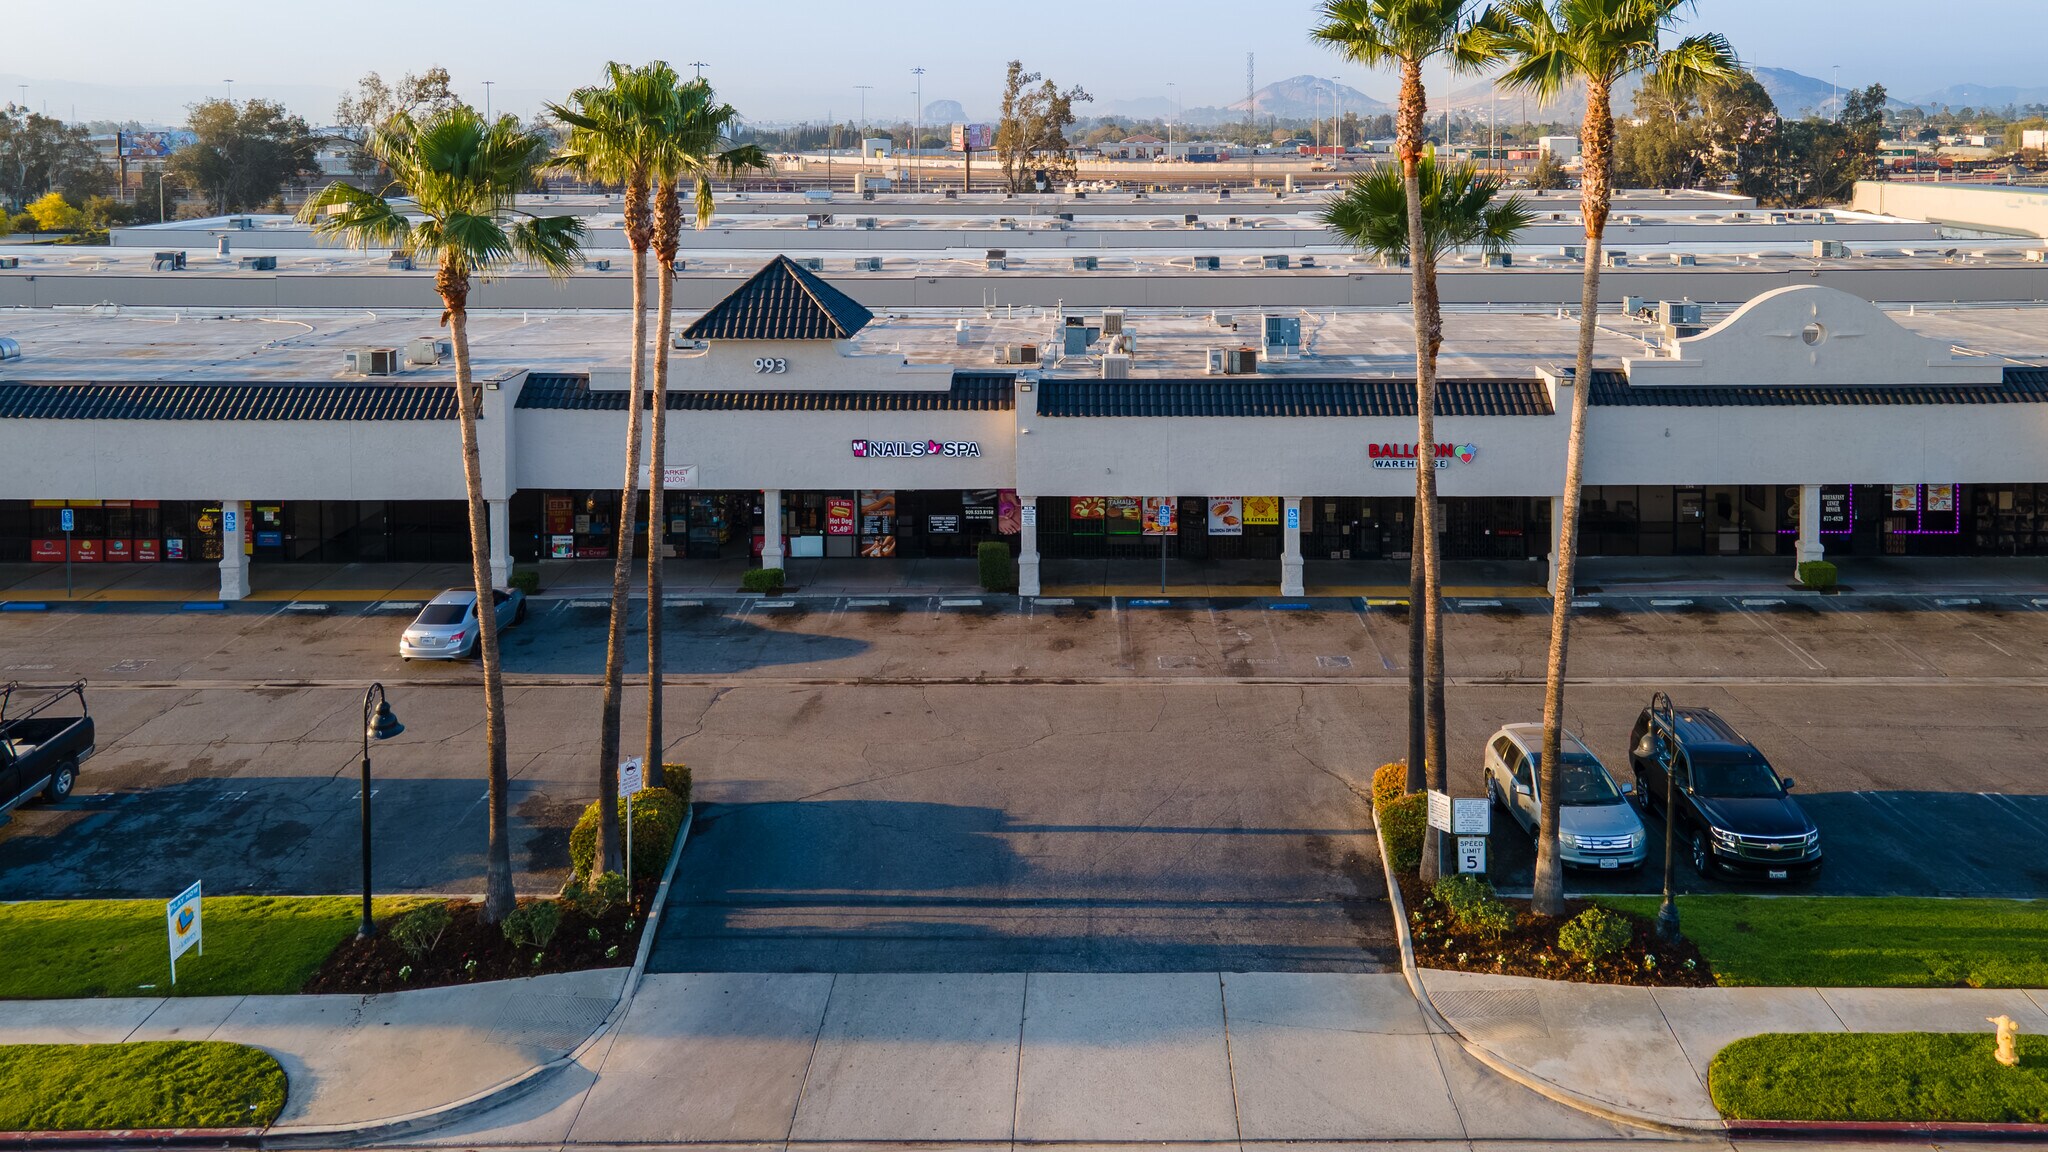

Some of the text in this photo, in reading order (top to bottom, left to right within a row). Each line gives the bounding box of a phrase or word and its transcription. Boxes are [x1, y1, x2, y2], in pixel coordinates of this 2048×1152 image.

[753, 358, 787, 374] 993
[870, 441, 980, 457] NAILS SPA
[1374, 460, 1446, 468] WAREHSE
[841, 517, 852, 525] Dog
[1466, 855, 1478, 869] 5
[170, 886, 198, 911] PLAY NOW
